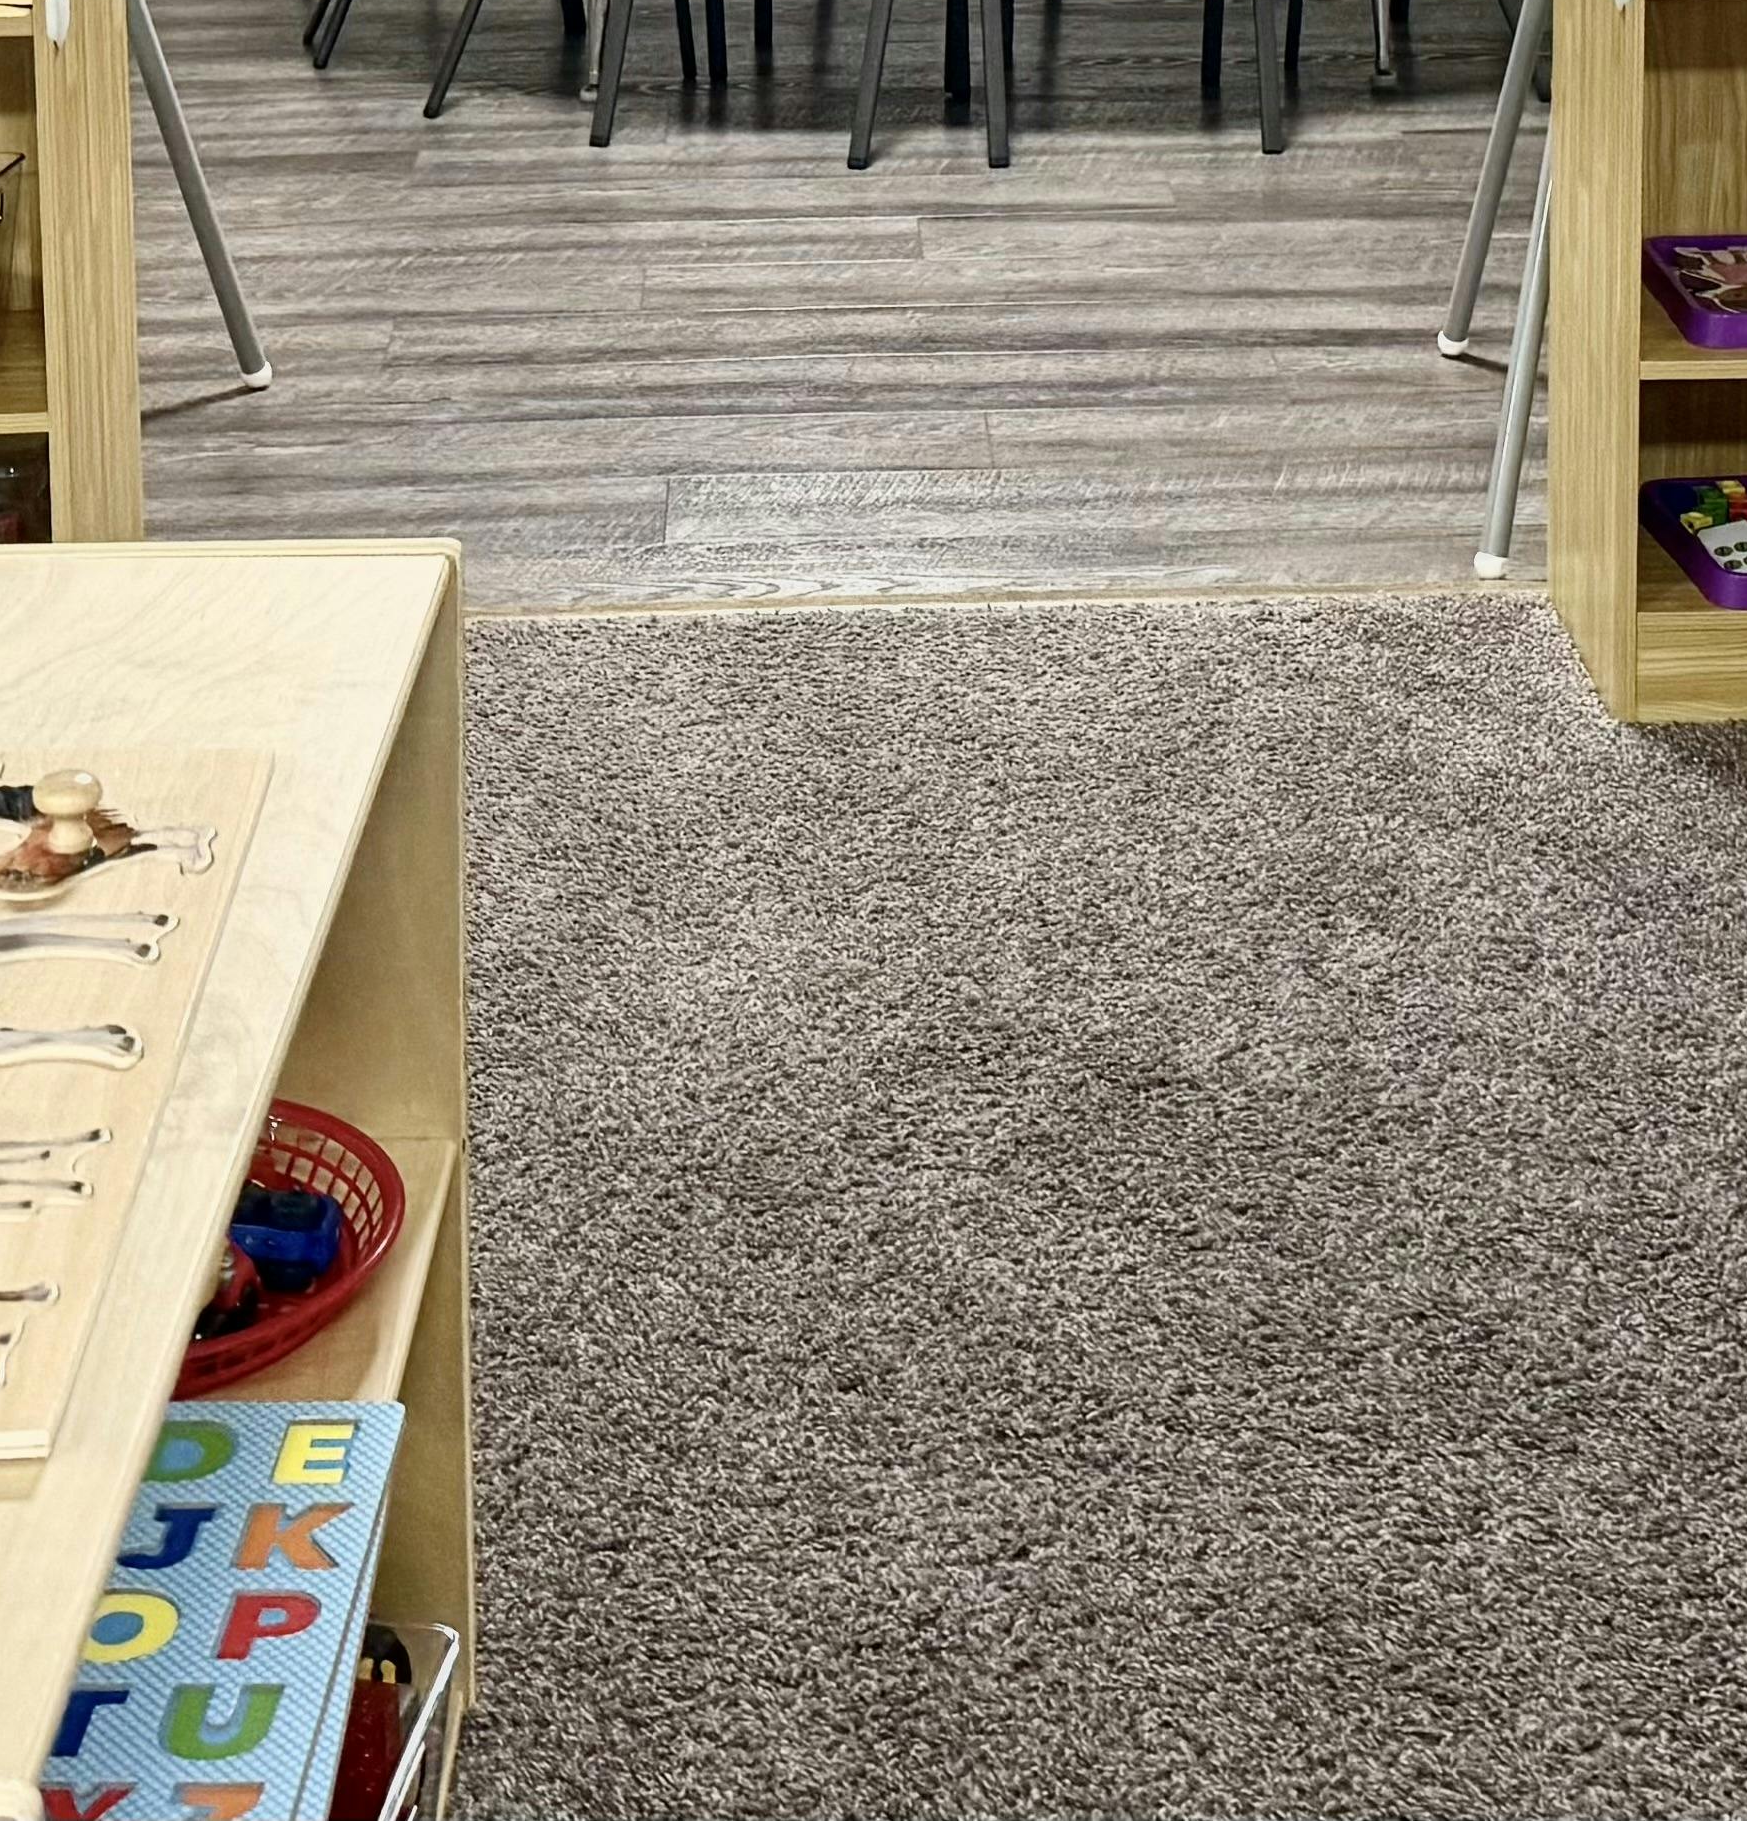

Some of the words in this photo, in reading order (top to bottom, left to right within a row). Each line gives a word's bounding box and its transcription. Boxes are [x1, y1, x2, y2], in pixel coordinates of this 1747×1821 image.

[143, 1420, 233, 1482] D
[273, 1420, 357, 1485] E
[117, 1502, 221, 1570] J
[232, 1502, 354, 1570] K
[82, 1589, 179, 1664] O
[216, 1589, 322, 1660] P
[162, 1683, 285, 1761] U
